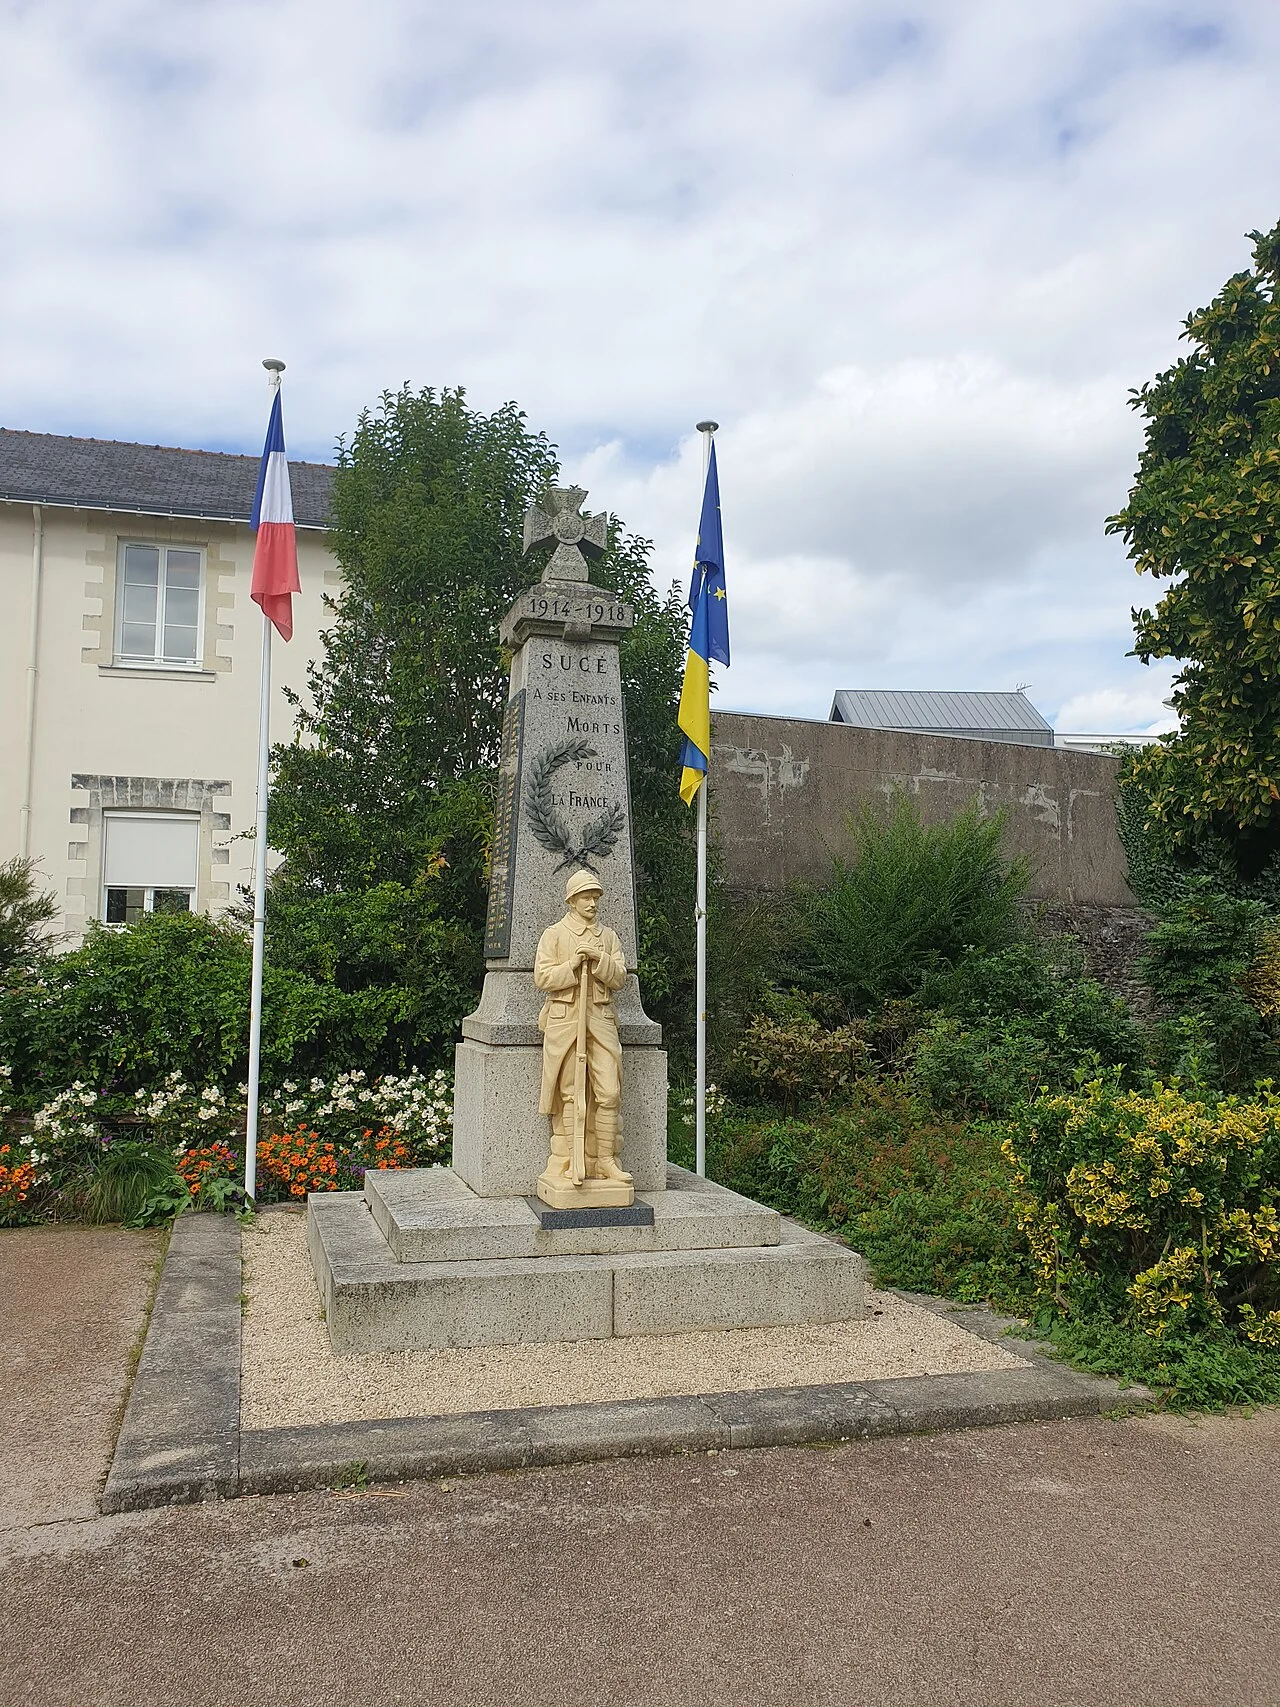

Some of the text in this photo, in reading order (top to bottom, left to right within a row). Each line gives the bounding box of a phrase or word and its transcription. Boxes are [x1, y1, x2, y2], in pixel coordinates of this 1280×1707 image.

[547, 692, 566, 702] SES
[566, 716, 620, 735] MORTS
[577, 761, 612, 772] POUR
[552, 790, 609, 808] LA FRANCE
